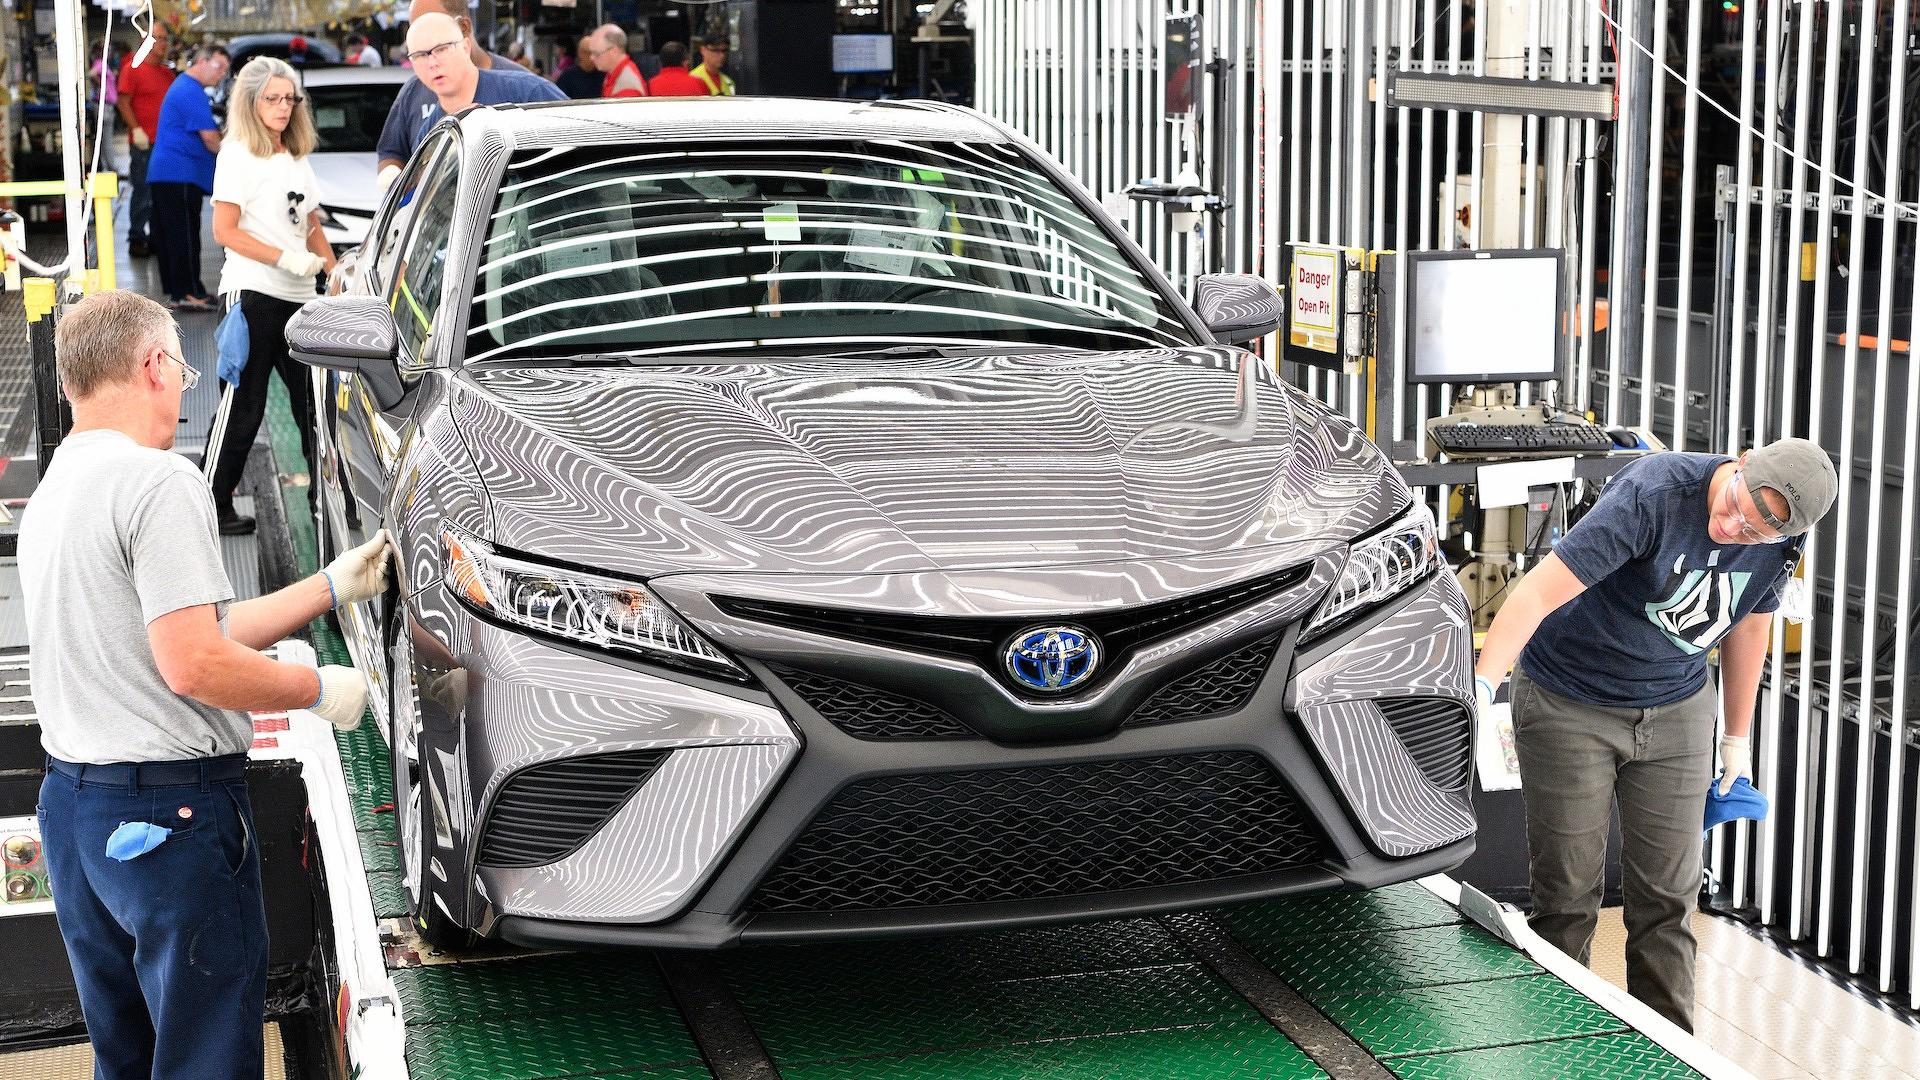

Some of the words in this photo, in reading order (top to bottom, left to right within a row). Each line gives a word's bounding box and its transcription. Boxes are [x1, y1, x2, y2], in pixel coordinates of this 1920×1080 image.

[1299, 267, 1331, 289] Danger
[1298, 297, 1318, 315] Open
[1319, 300, 1330, 315] Pit
[1785, 482, 1801, 502] POLO
